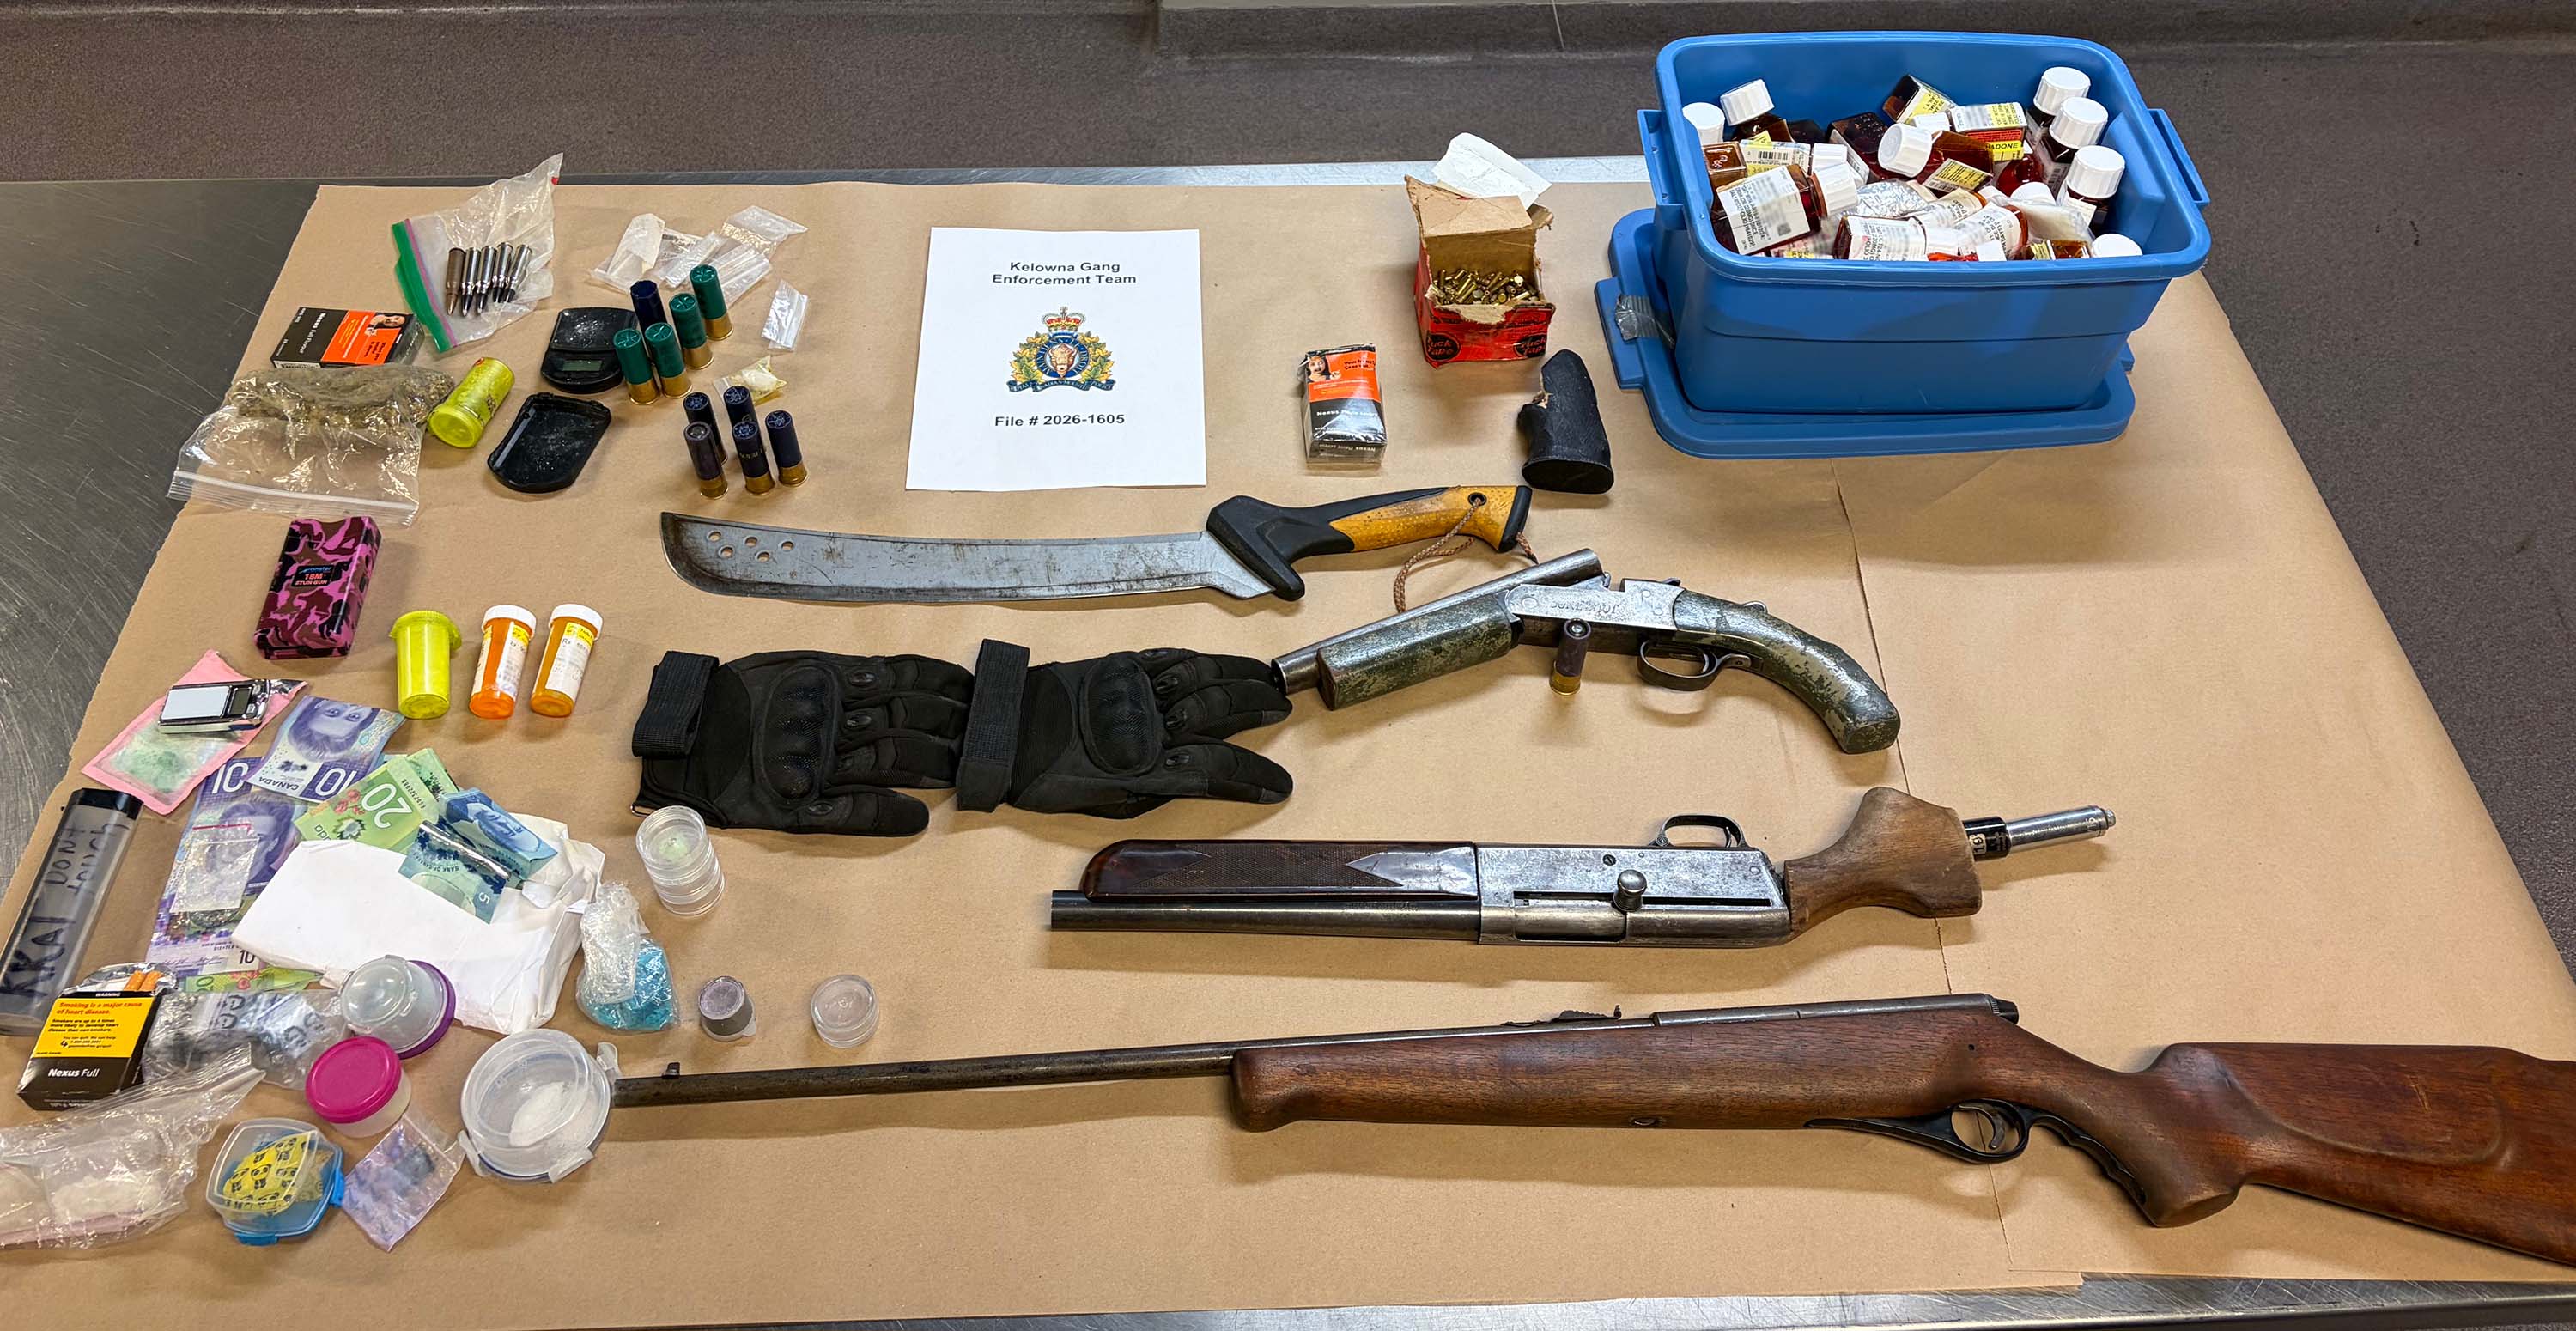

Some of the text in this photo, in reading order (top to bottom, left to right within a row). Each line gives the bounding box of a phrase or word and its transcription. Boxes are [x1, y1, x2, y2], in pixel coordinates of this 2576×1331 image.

[1010, 262, 1121, 273] Kelowna Gang
[992, 274, 1137, 285] Enforcement Team
[994, 415, 1125, 427] File # 2026-1605
[258, 775, 300, 791] CANADA
[361, 783, 412, 829] 20
[477, 891, 490, 905] 5
[47, 1068, 100, 1077] Nexus Full
